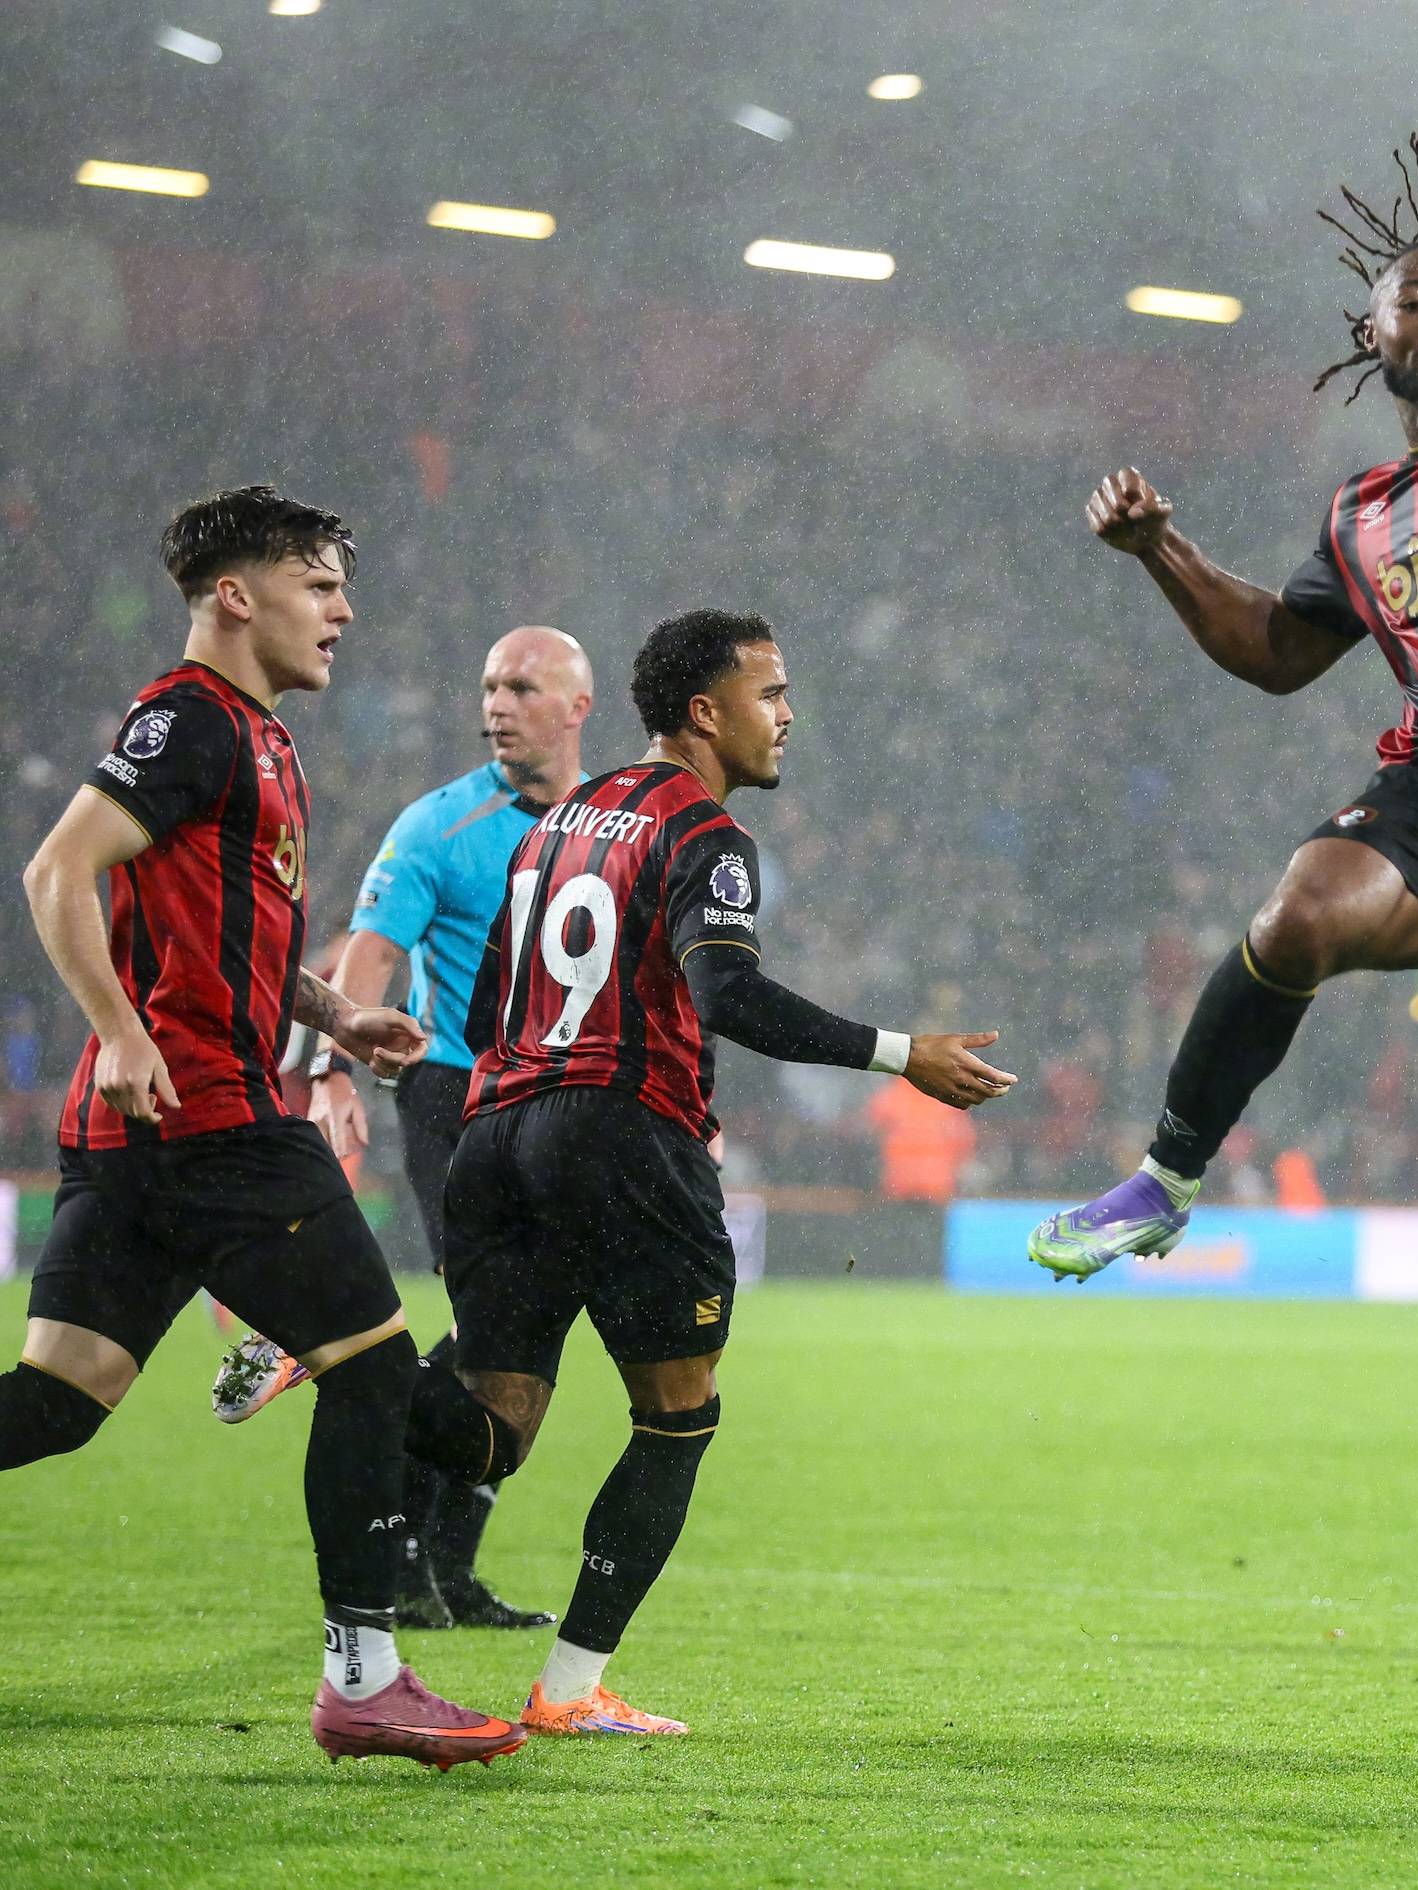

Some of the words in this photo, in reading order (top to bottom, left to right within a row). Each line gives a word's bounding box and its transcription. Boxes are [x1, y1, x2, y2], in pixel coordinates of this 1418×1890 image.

[615, 777, 637, 787] AFCB
[534, 802, 655, 844] KLUIVERT
[704, 906, 722, 918] No
[723, 910, 753, 925] room
[503, 868, 617, 1048] 19
